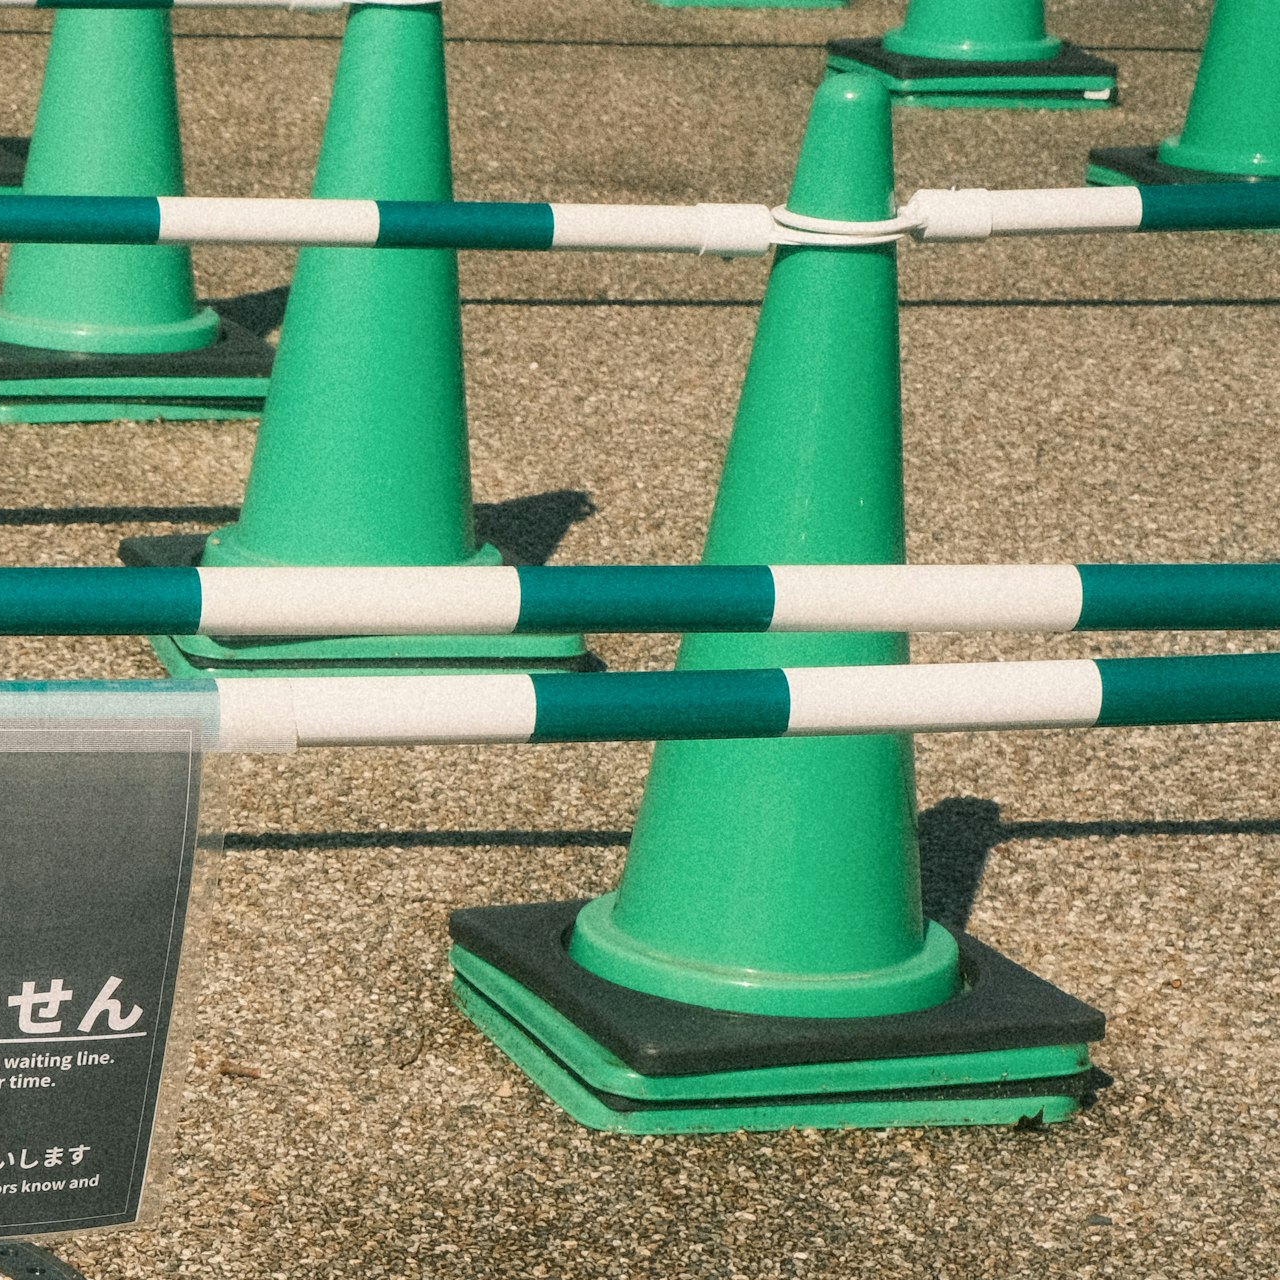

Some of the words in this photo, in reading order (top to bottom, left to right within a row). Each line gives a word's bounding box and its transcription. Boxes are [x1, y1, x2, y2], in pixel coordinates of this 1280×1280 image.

[4, 1053, 73, 1070] waiting
[77, 1051, 114, 1066] line.
[10, 1074, 55, 1088] time.
[21, 1177, 66, 1193] know
[69, 1174, 99, 1189] and
